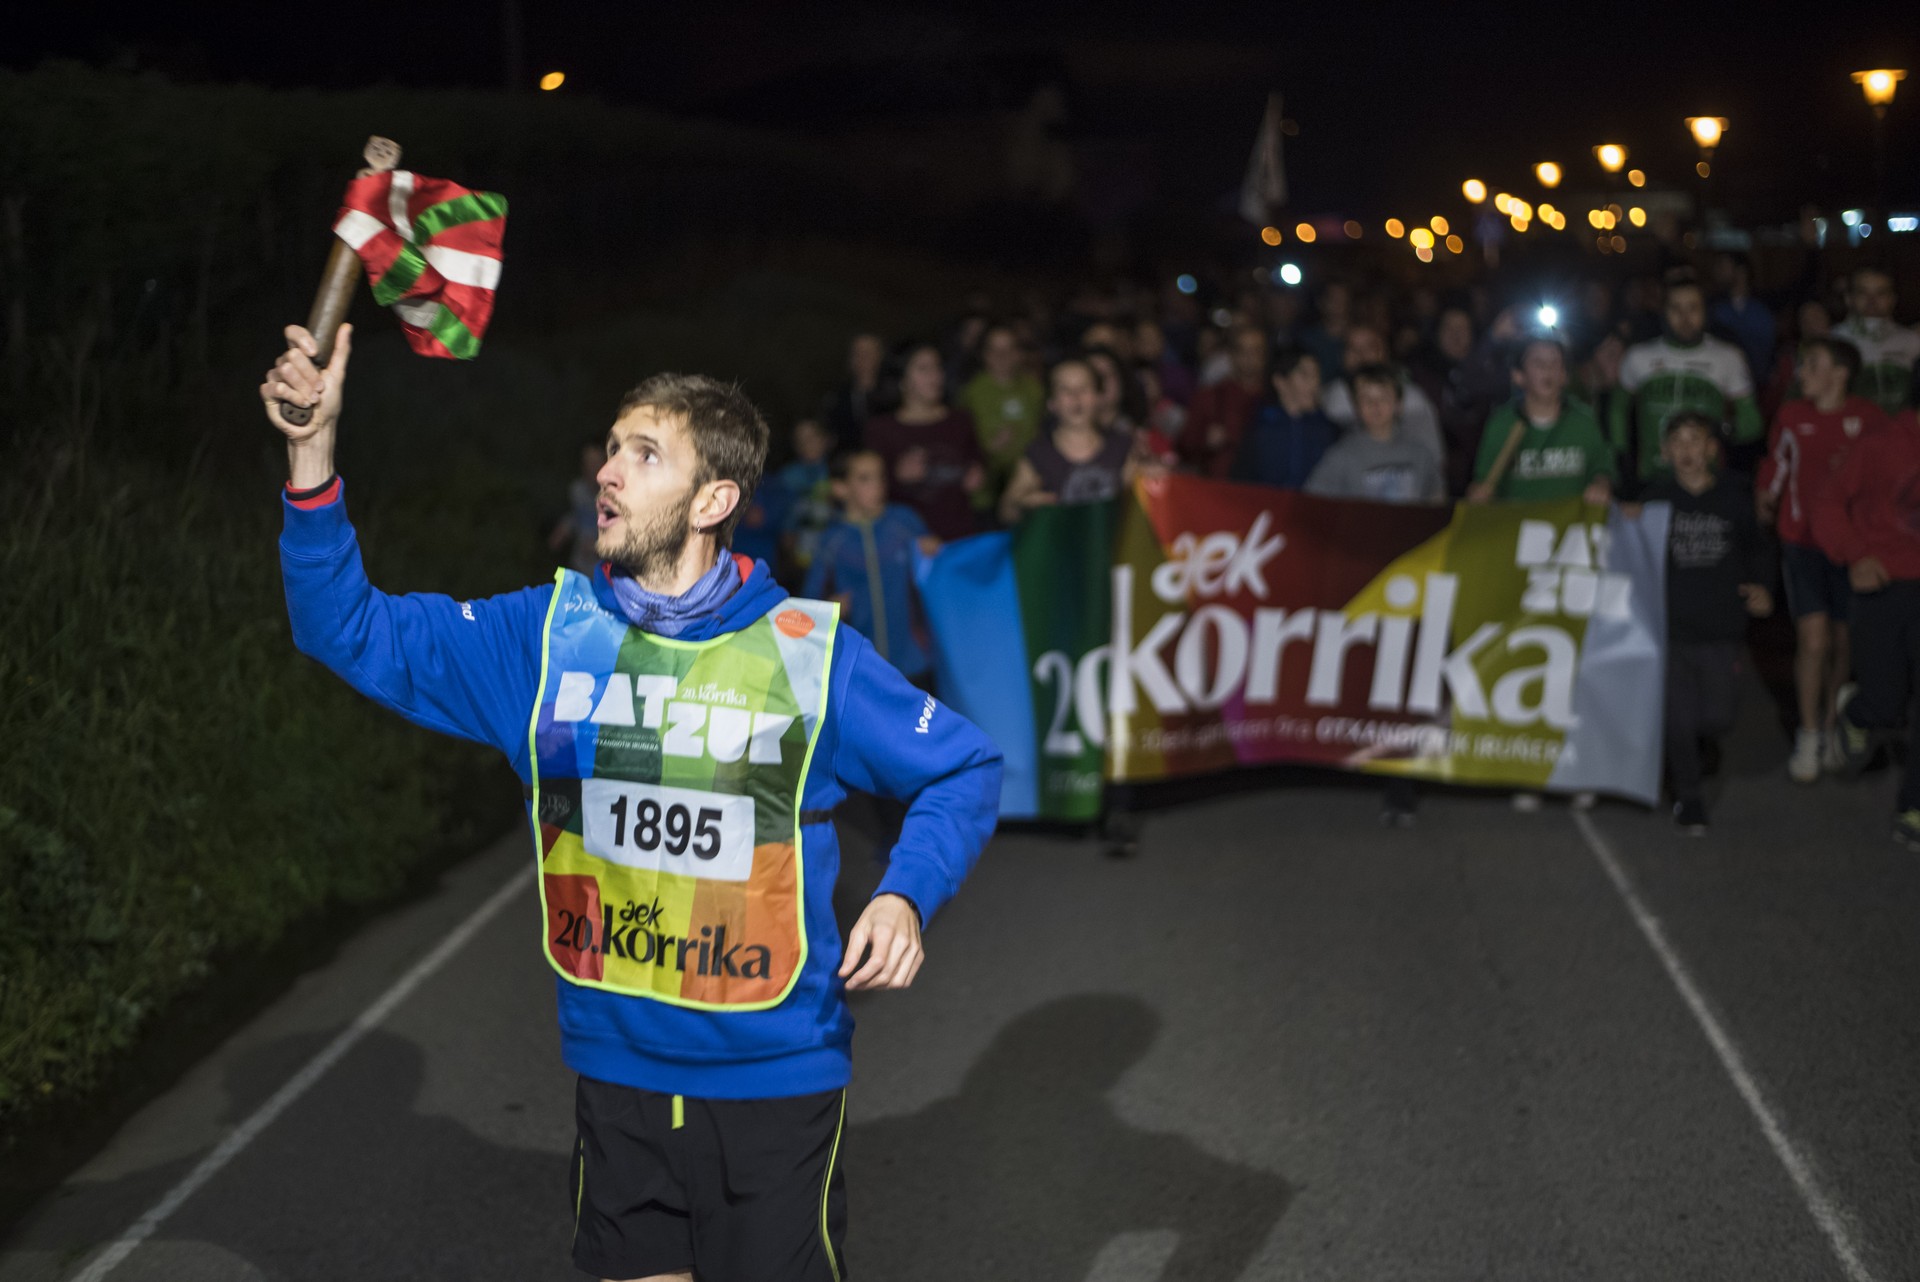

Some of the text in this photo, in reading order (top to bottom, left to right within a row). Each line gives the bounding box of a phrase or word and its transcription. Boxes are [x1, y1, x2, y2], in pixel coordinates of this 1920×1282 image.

[1151, 511, 1287, 604] aek
[554, 671, 678, 728] BAT
[662, 702, 795, 764] ZUK
[610, 794, 723, 860] 1895
[620, 896, 664, 927] aek
